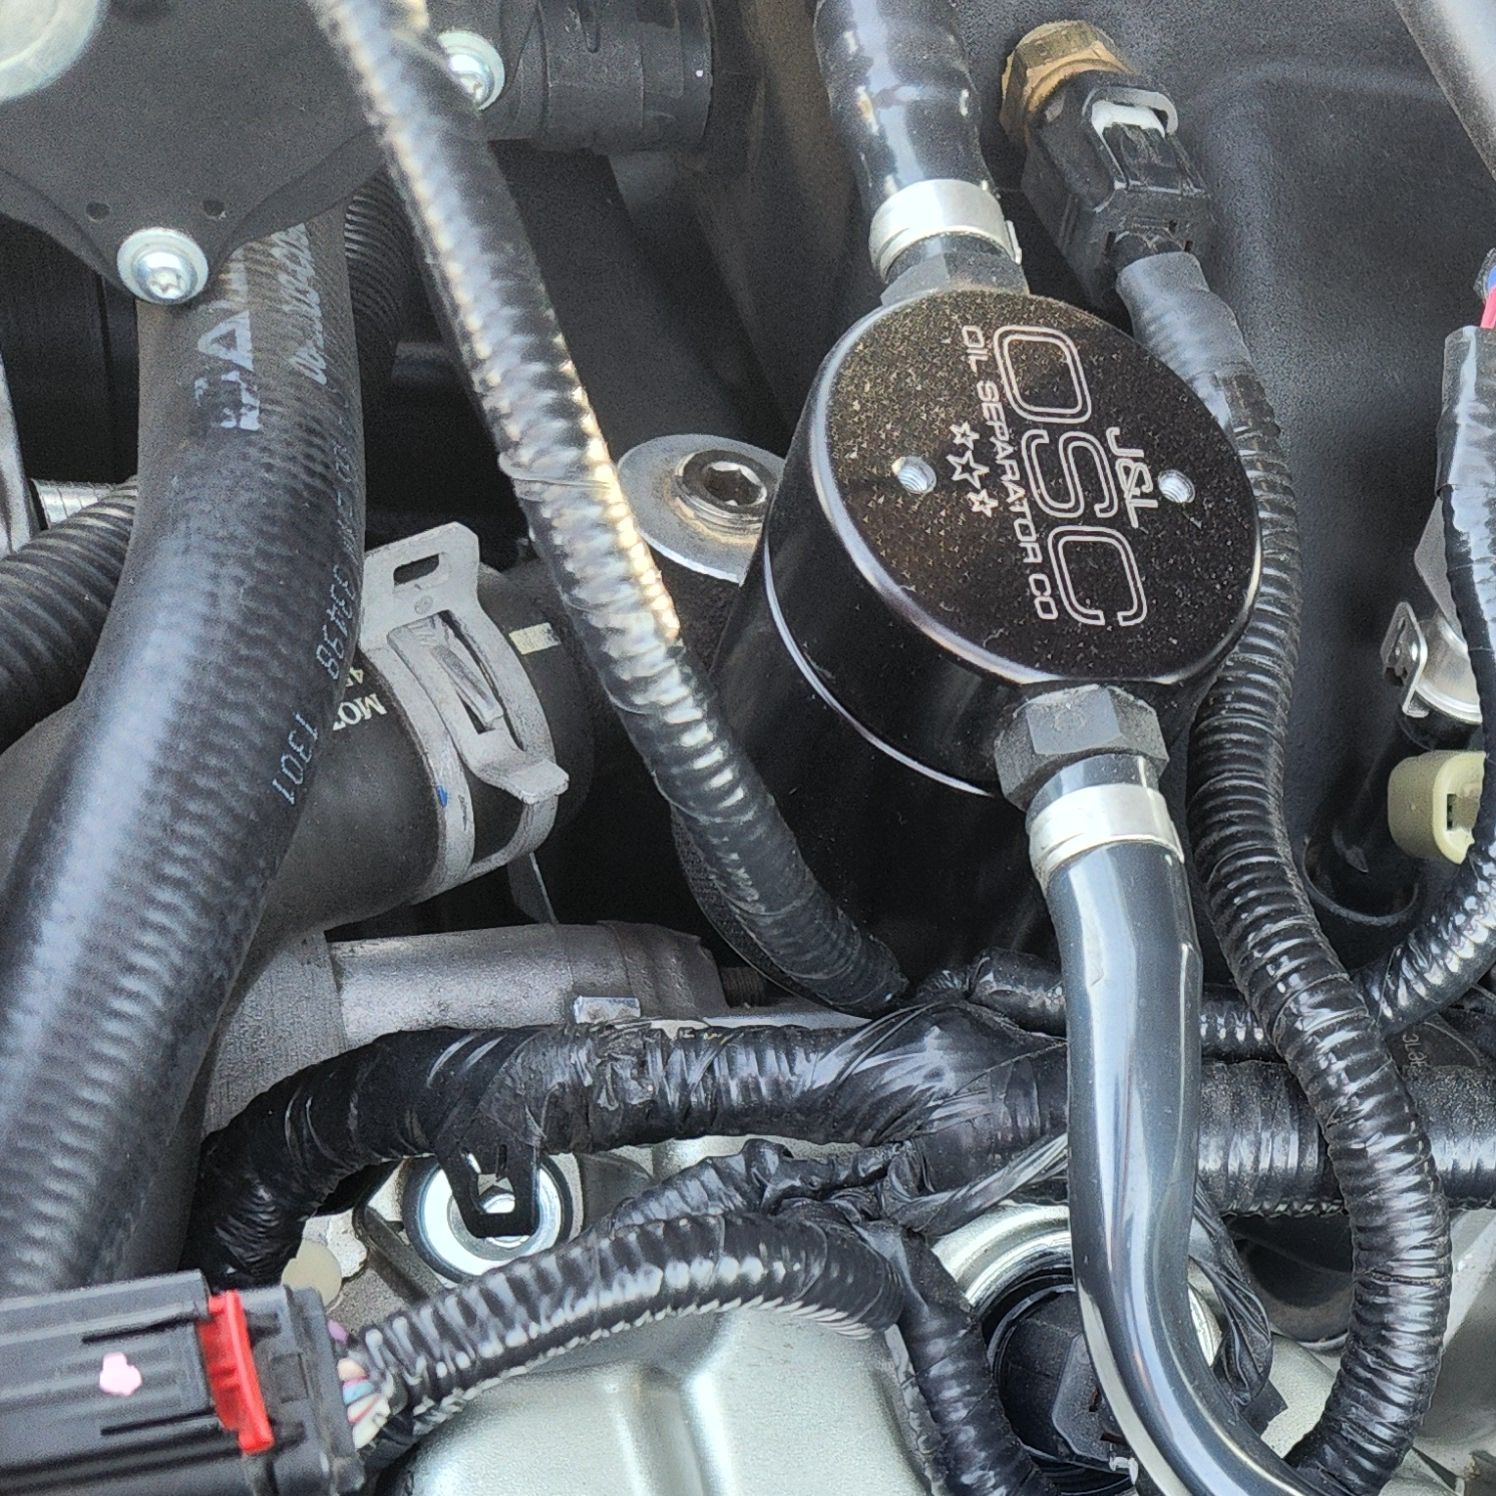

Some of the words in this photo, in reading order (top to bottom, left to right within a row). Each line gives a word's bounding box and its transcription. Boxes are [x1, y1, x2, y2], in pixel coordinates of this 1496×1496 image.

[961, 325, 989, 373] OIL
[976, 380, 1042, 563] SEPARATOR
[1028, 573, 1058, 619] CO
[993, 325, 1148, 626] OSC
[1105, 426, 1159, 528] J&L
[272, 712, 319, 805] 1301
